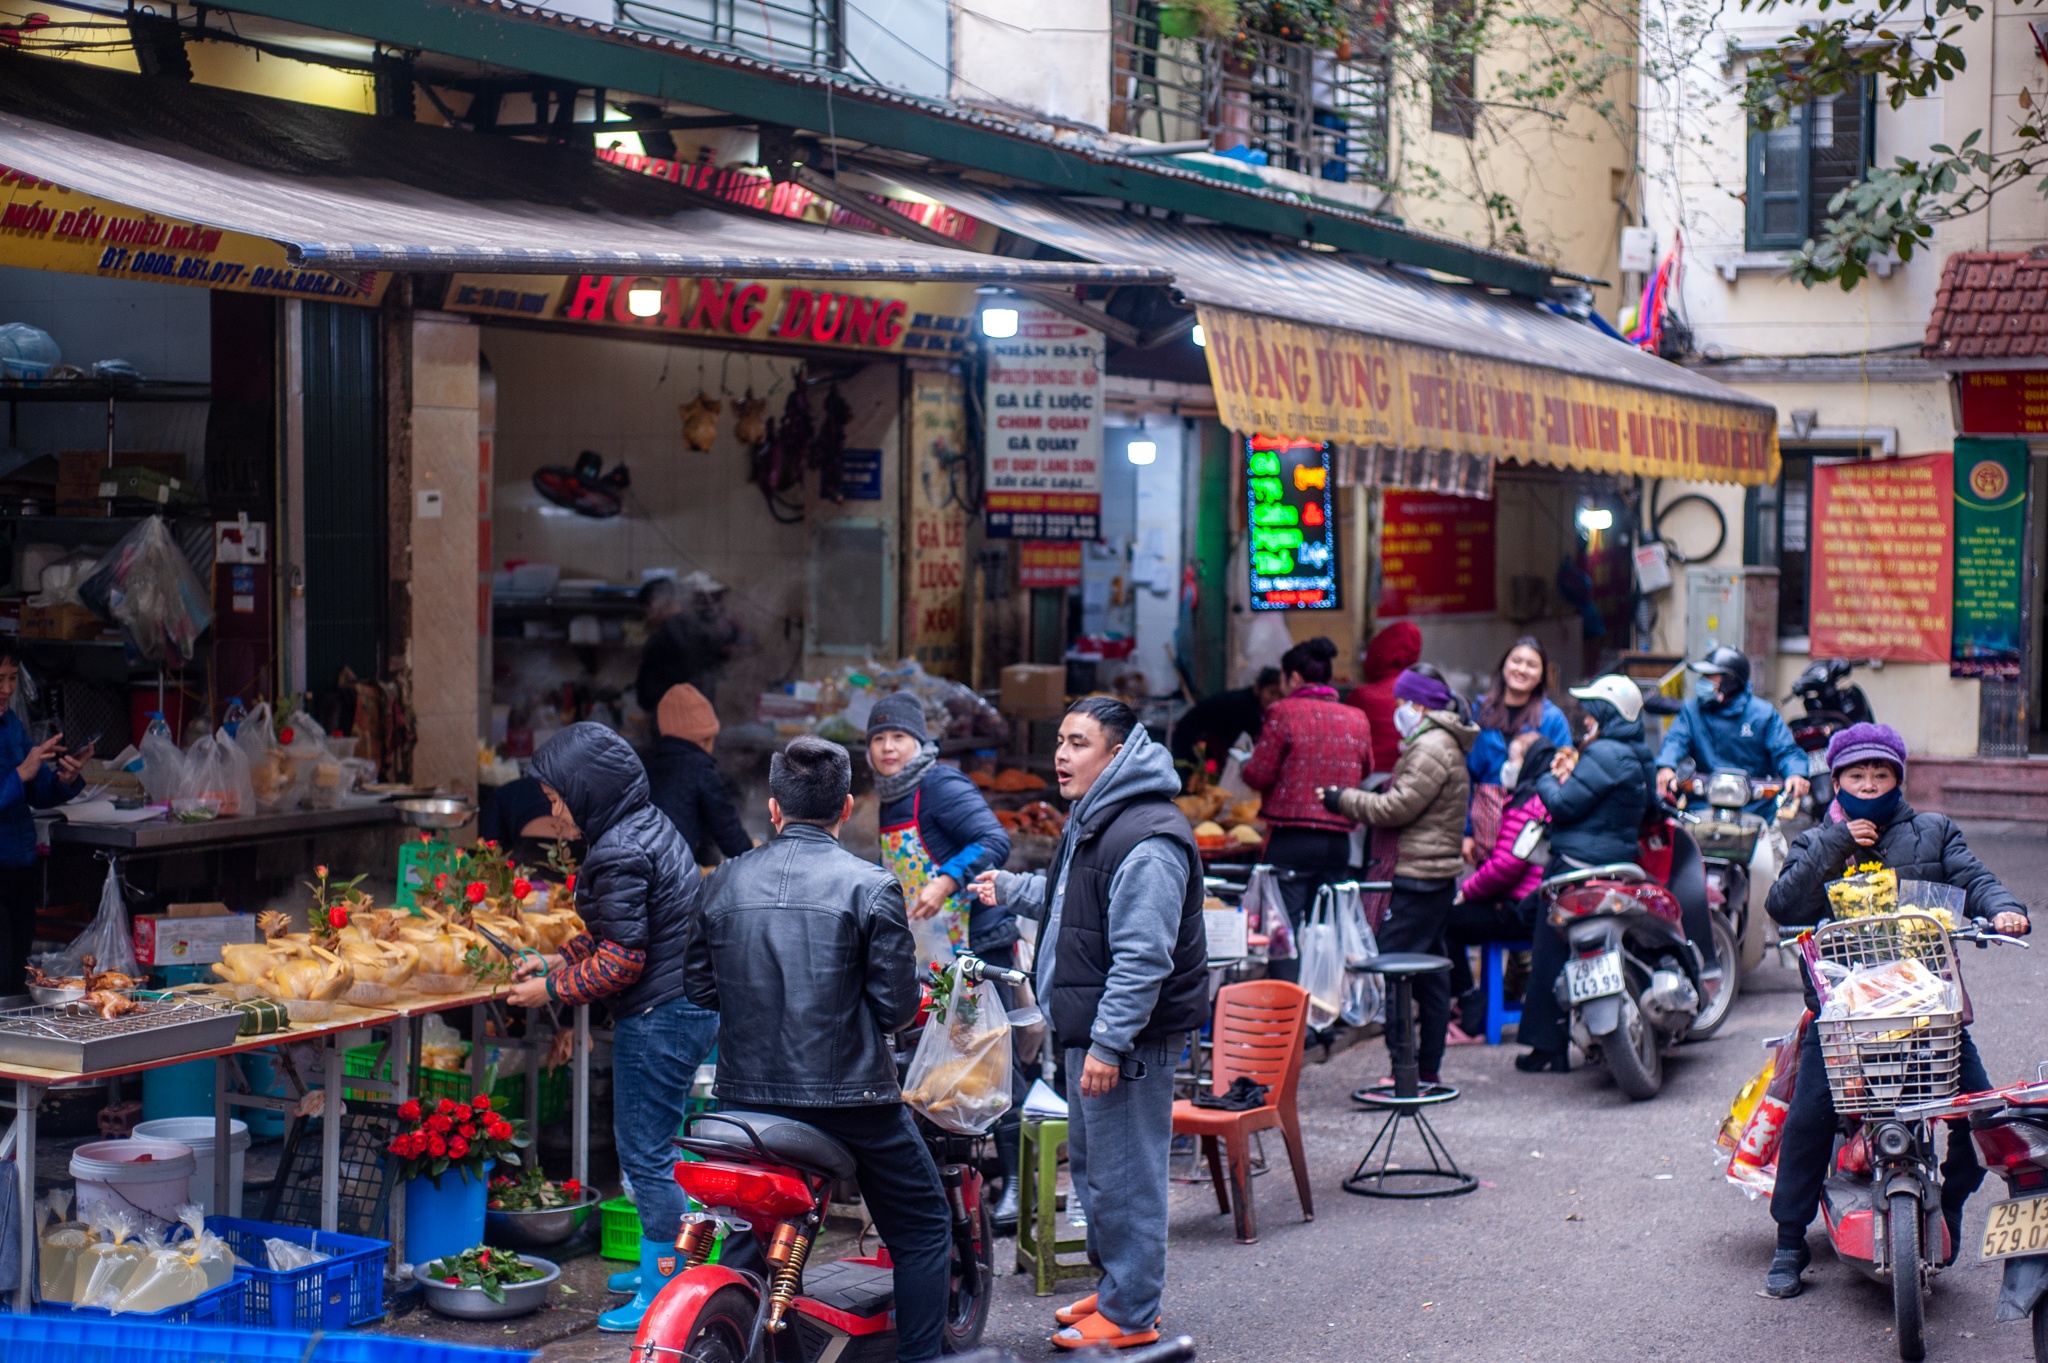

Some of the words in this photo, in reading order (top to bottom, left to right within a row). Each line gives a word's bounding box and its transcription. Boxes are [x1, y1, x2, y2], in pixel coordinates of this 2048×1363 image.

[1, 199, 57, 234] MÓN
[56, 206, 105, 239] ĐẾN
[102, 213, 168, 246] NHIỀU
[99, 246, 132, 271] ĐT:
[776, 287, 908, 348] DUNG
[1212, 320, 1311, 405] HOÀNG
[1315, 348, 1391, 412] DUNG
[995, 392, 1019, 408] GÀ
[1049, 392, 1093, 411] LUỘC
[997, 415, 1042, 431] CHIM
[1047, 415, 1091, 432] QUAY
[1008, 435, 1030, 451] GÀ
[1036, 436, 1079, 452] QUAY
[917, 513, 940, 549] GÀ
